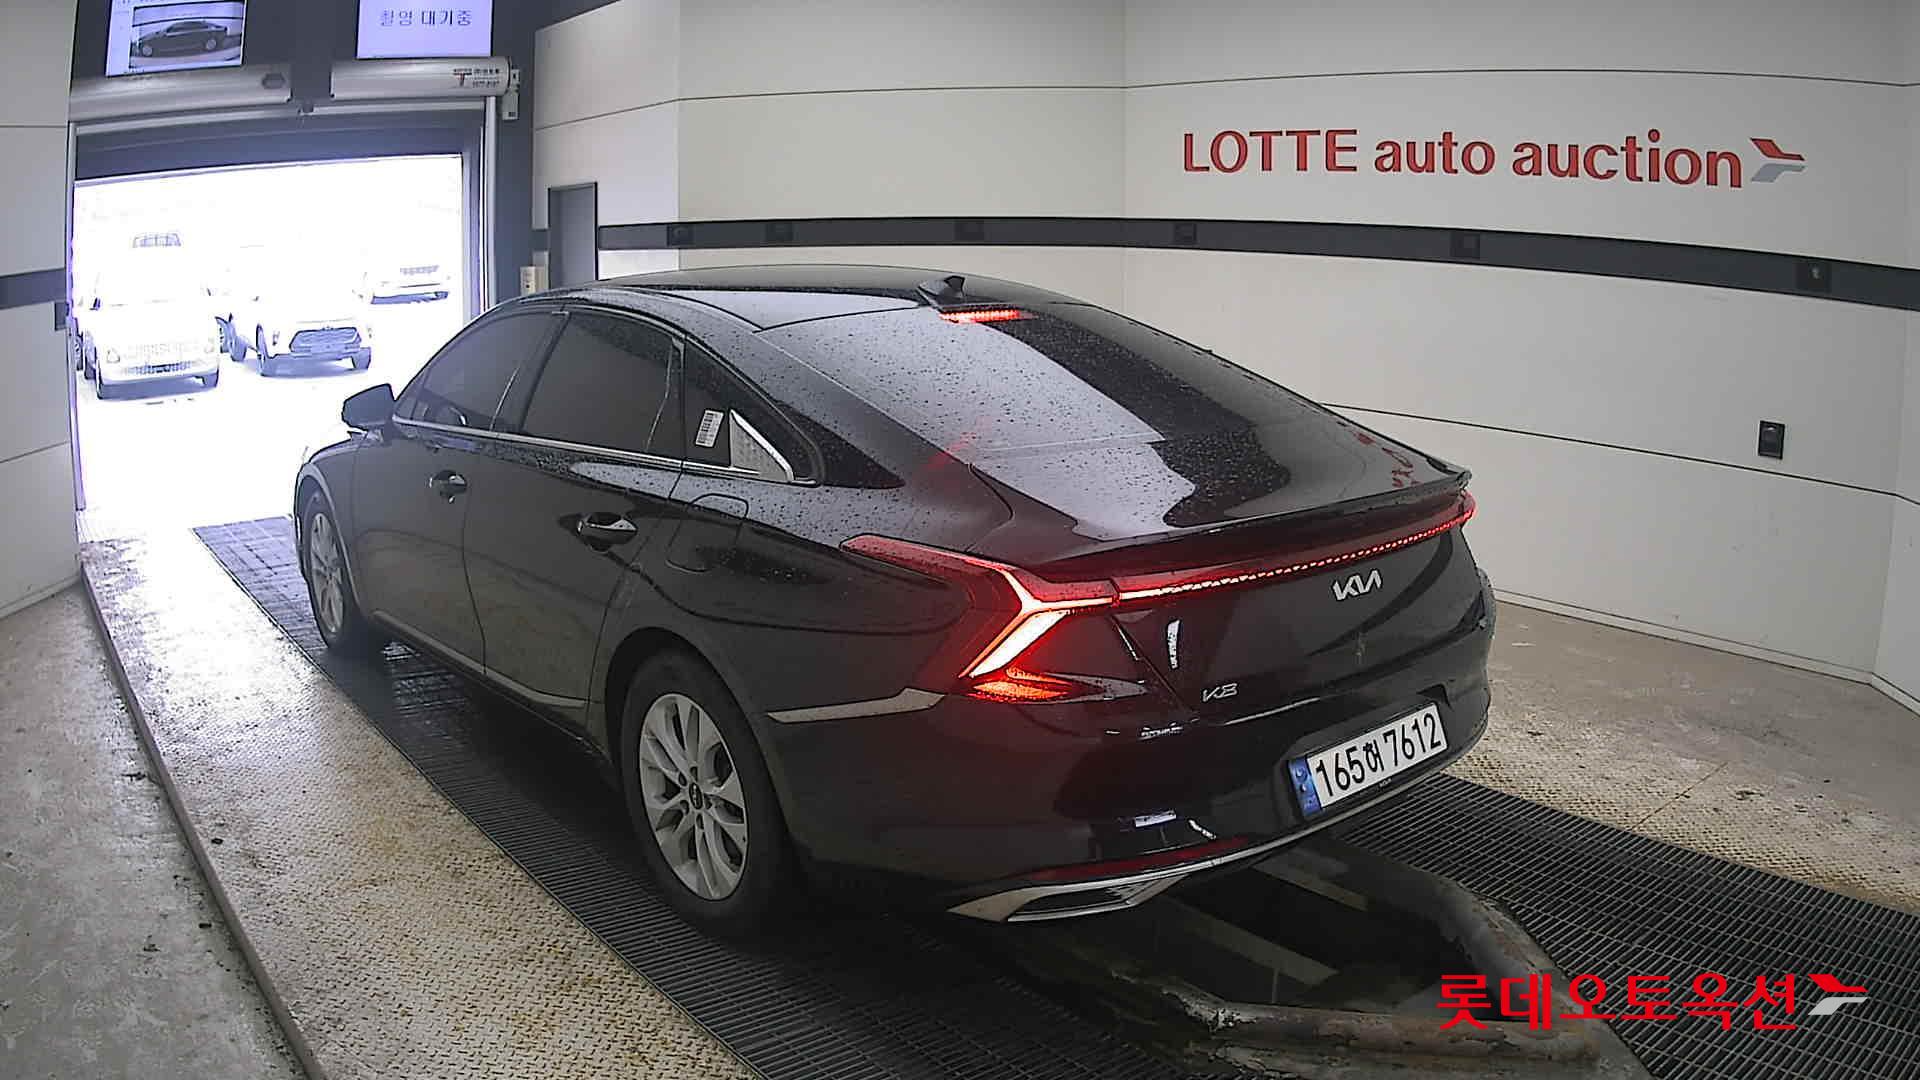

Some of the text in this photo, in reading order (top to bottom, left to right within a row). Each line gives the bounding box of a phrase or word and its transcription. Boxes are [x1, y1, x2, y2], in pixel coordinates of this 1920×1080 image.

[421, 8, 472, 26] 대기중
[1182, 128, 1743, 189] LOTTE auto auction
[1332, 569, 1383, 601] KIA
[1202, 682, 1239, 703] K8
[1383, 712, 1442, 767] 7612
